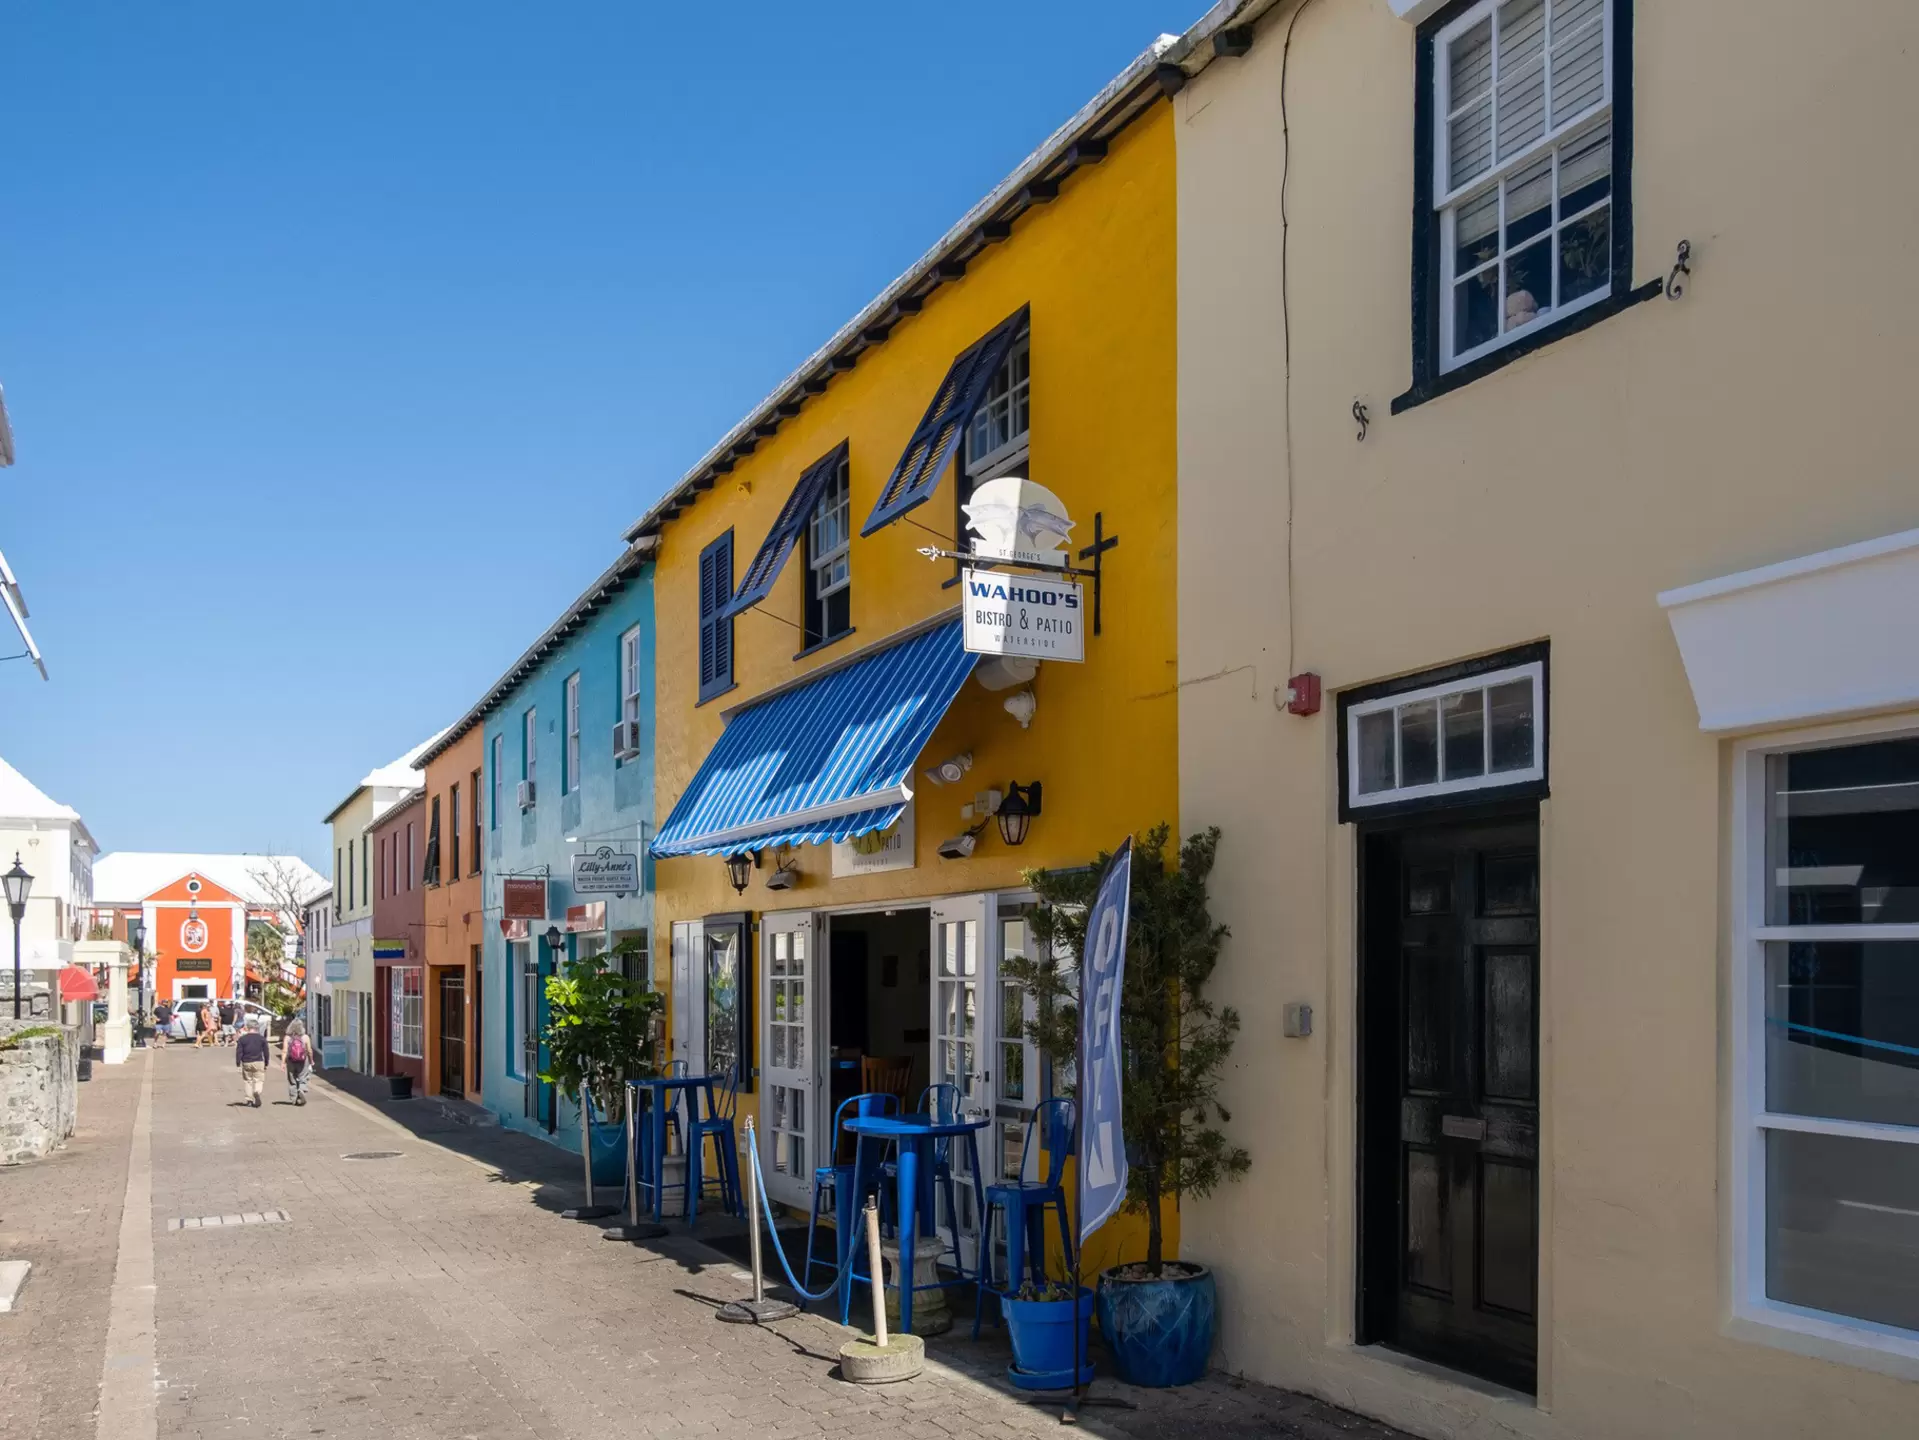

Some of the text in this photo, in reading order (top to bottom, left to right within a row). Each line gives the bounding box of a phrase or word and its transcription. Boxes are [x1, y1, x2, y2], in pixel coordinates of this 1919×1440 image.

[969, 581, 1078, 609] WAHOO'S
[976, 608, 1072, 635] BISTRO & PATIO
[880, 834, 902, 852] PATIO
[578, 860, 632, 874] Lilly-Anne's
